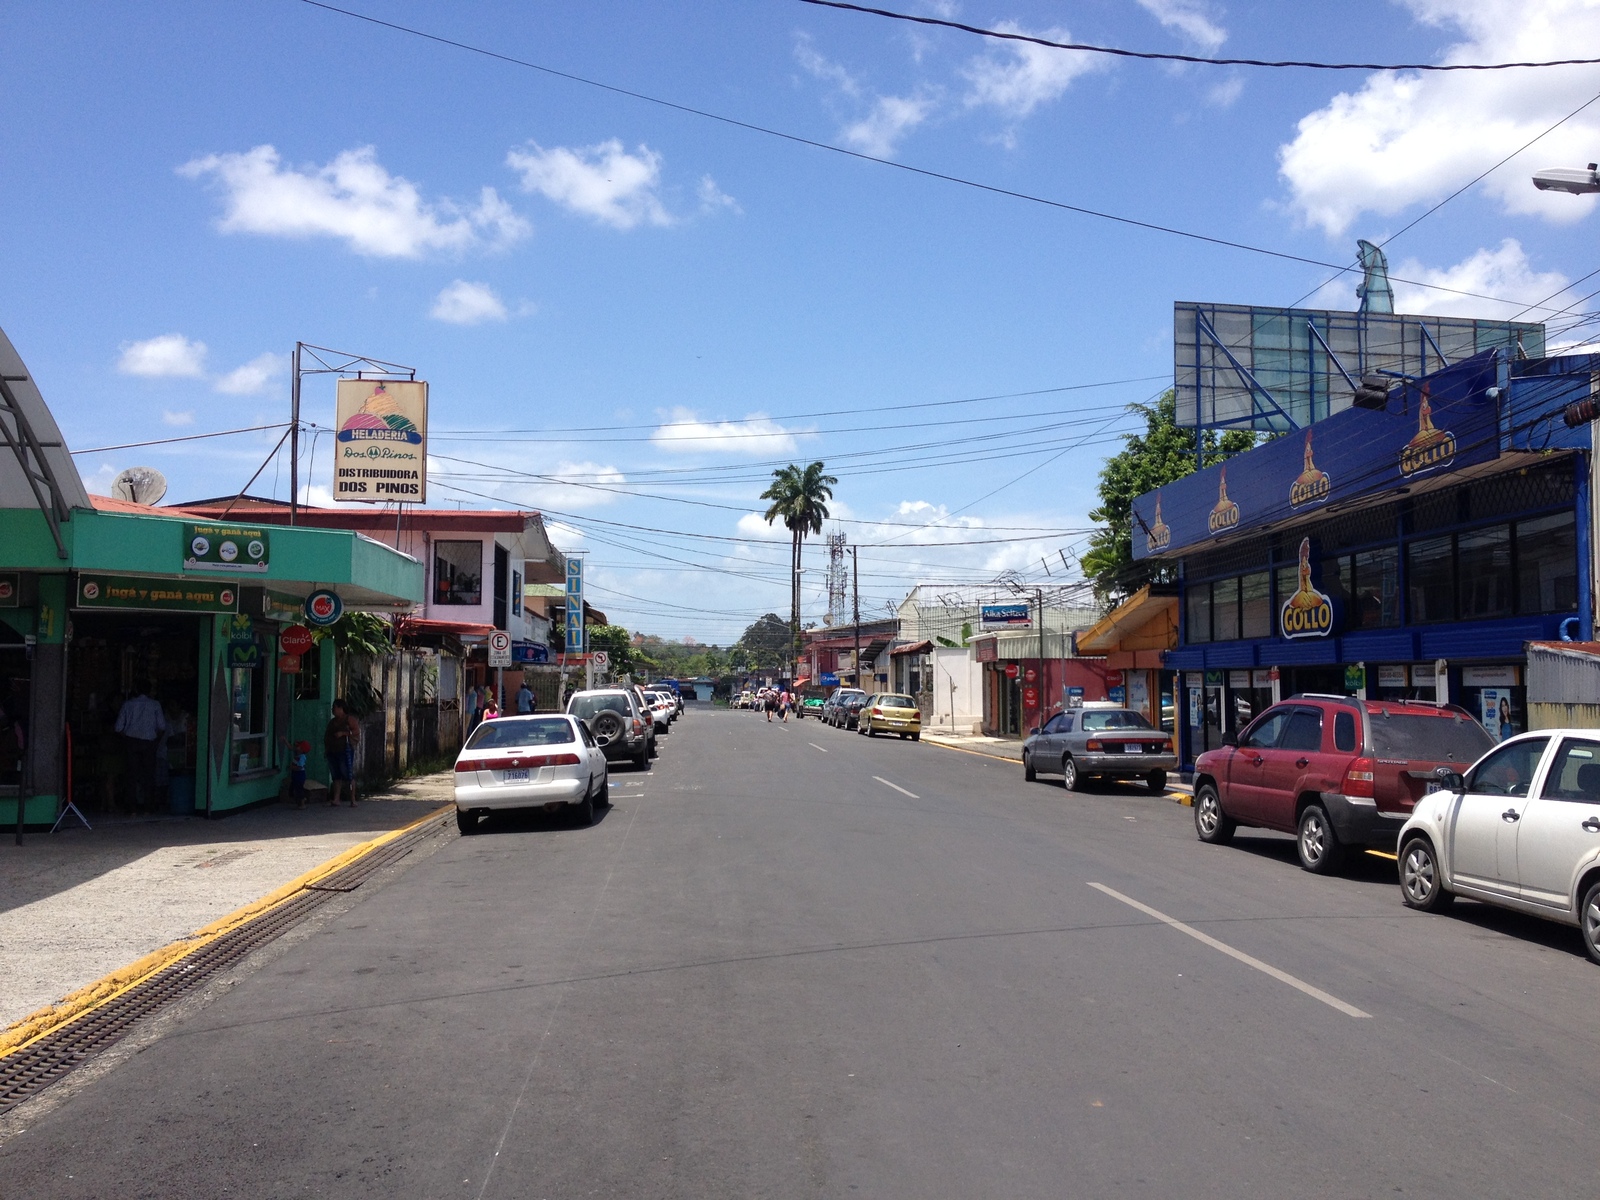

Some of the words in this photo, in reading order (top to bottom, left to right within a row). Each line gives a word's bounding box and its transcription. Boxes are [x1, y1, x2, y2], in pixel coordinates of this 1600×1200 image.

[344, 447, 367, 458] Dos
[382, 447, 417, 460] Pinos
[1401, 436, 1454, 473] GOLLO
[339, 468, 418, 479] DISTRIBUIDORA
[339, 482, 367, 492] DOS
[376, 483, 418, 494] PINOS
[1291, 476, 1329, 504] GOLLO
[1209, 506, 1238, 530] GOLLO
[569, 561, 580, 645] SINAI
[1284, 603, 1330, 632] GOLLO
[282, 636, 307, 644] Claro
[497, 636, 503, 647] E
